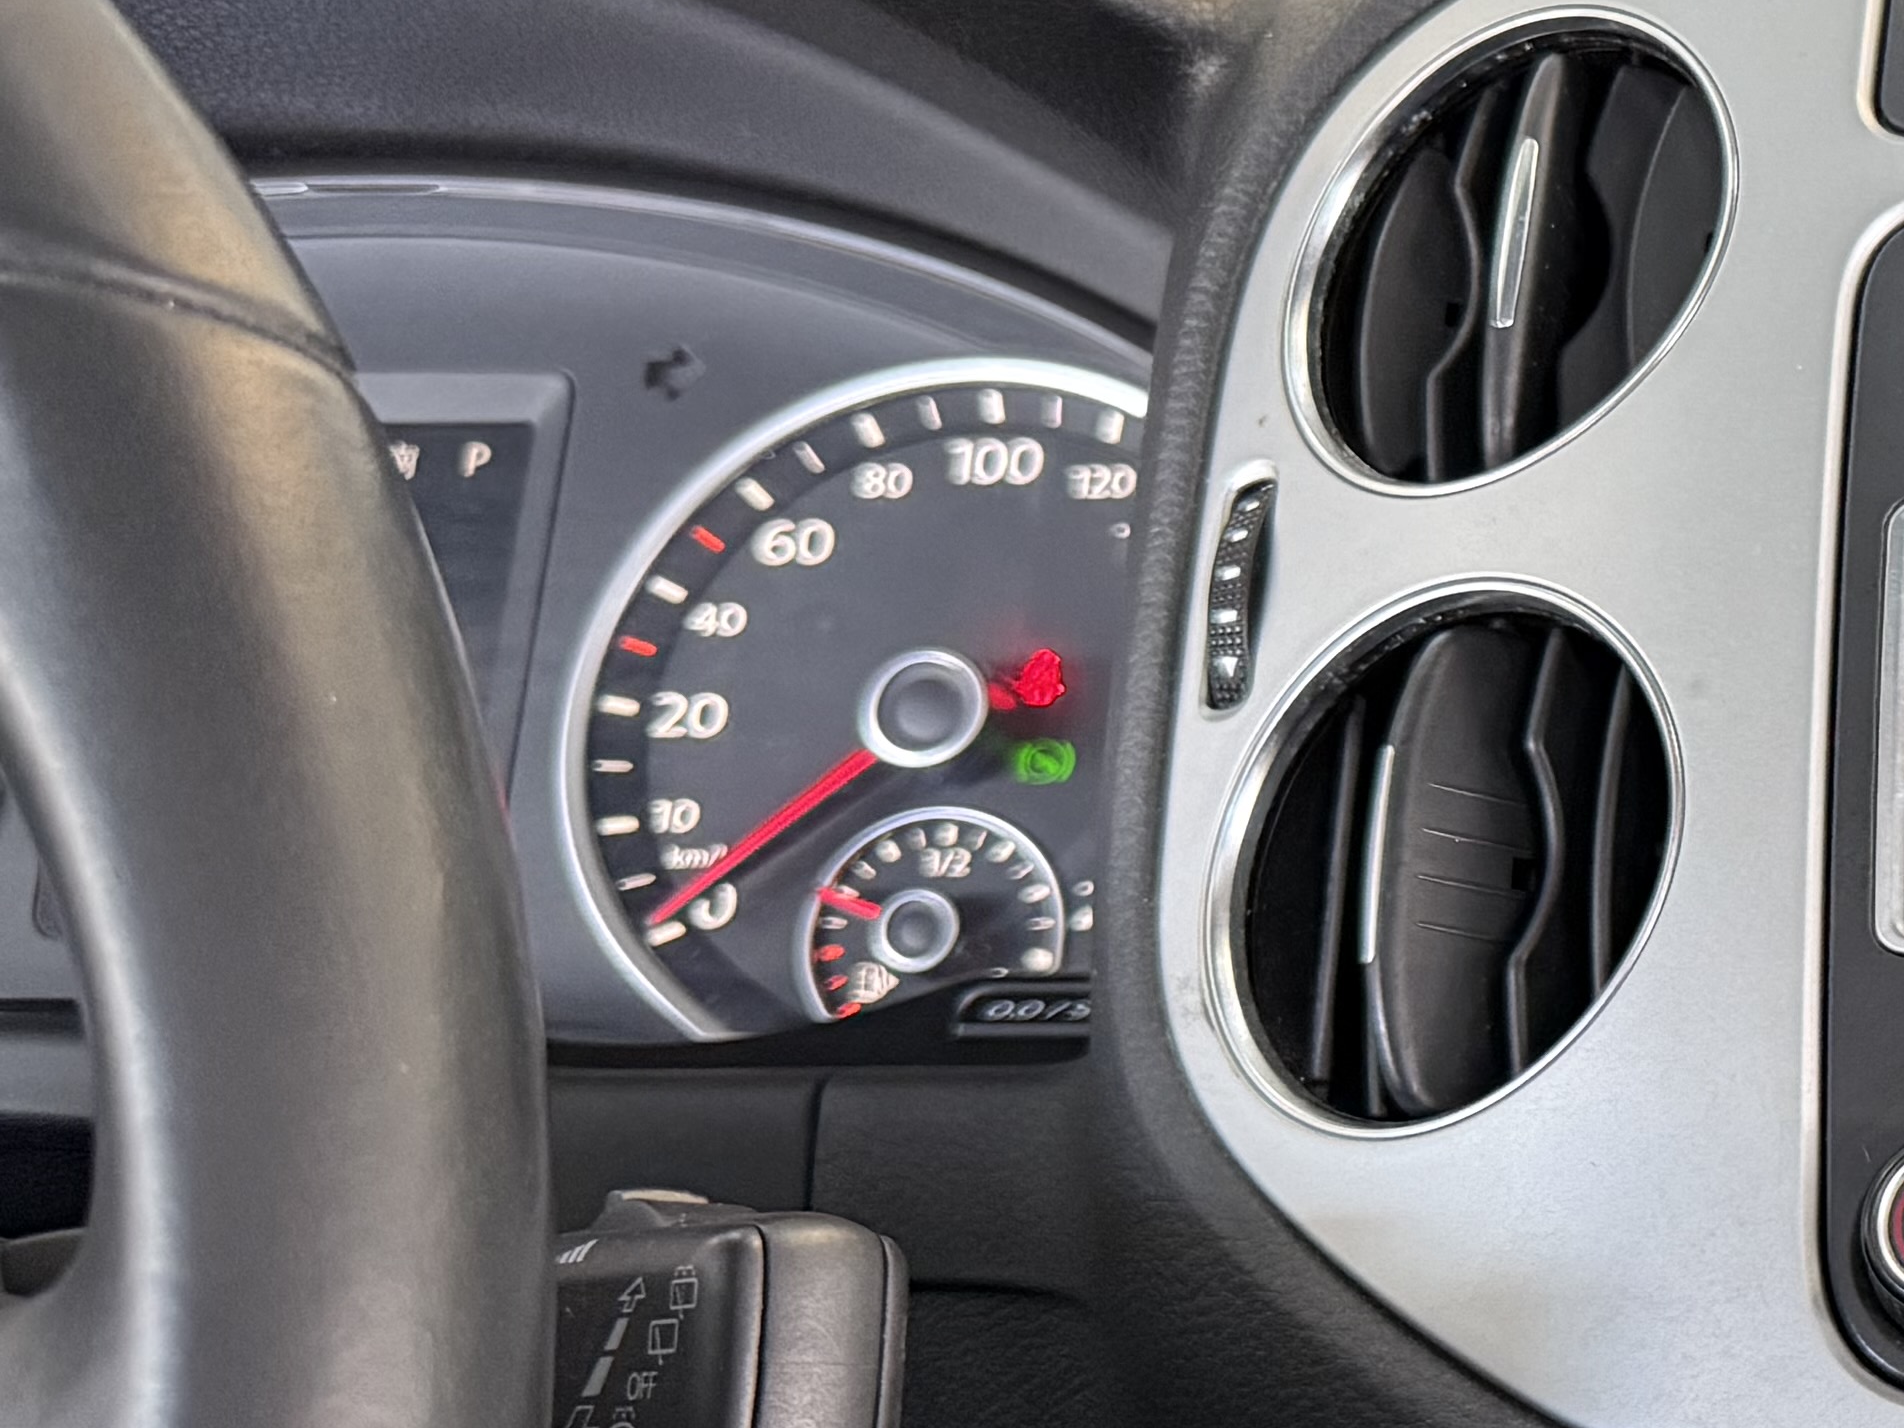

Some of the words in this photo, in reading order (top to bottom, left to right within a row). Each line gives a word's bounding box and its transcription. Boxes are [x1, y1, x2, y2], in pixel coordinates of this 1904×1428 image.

[943, 437, 1045, 487] 100
[1064, 462, 1138, 500] 120
[851, 463, 914, 500] 80
[750, 518, 836, 567] 60
[685, 600, 748, 638] 40
[647, 691, 729, 739] 20
[649, 797, 701, 834] 10
[918, 847, 972, 878] 1/2
[626, 1371, 658, 1401] OFF
